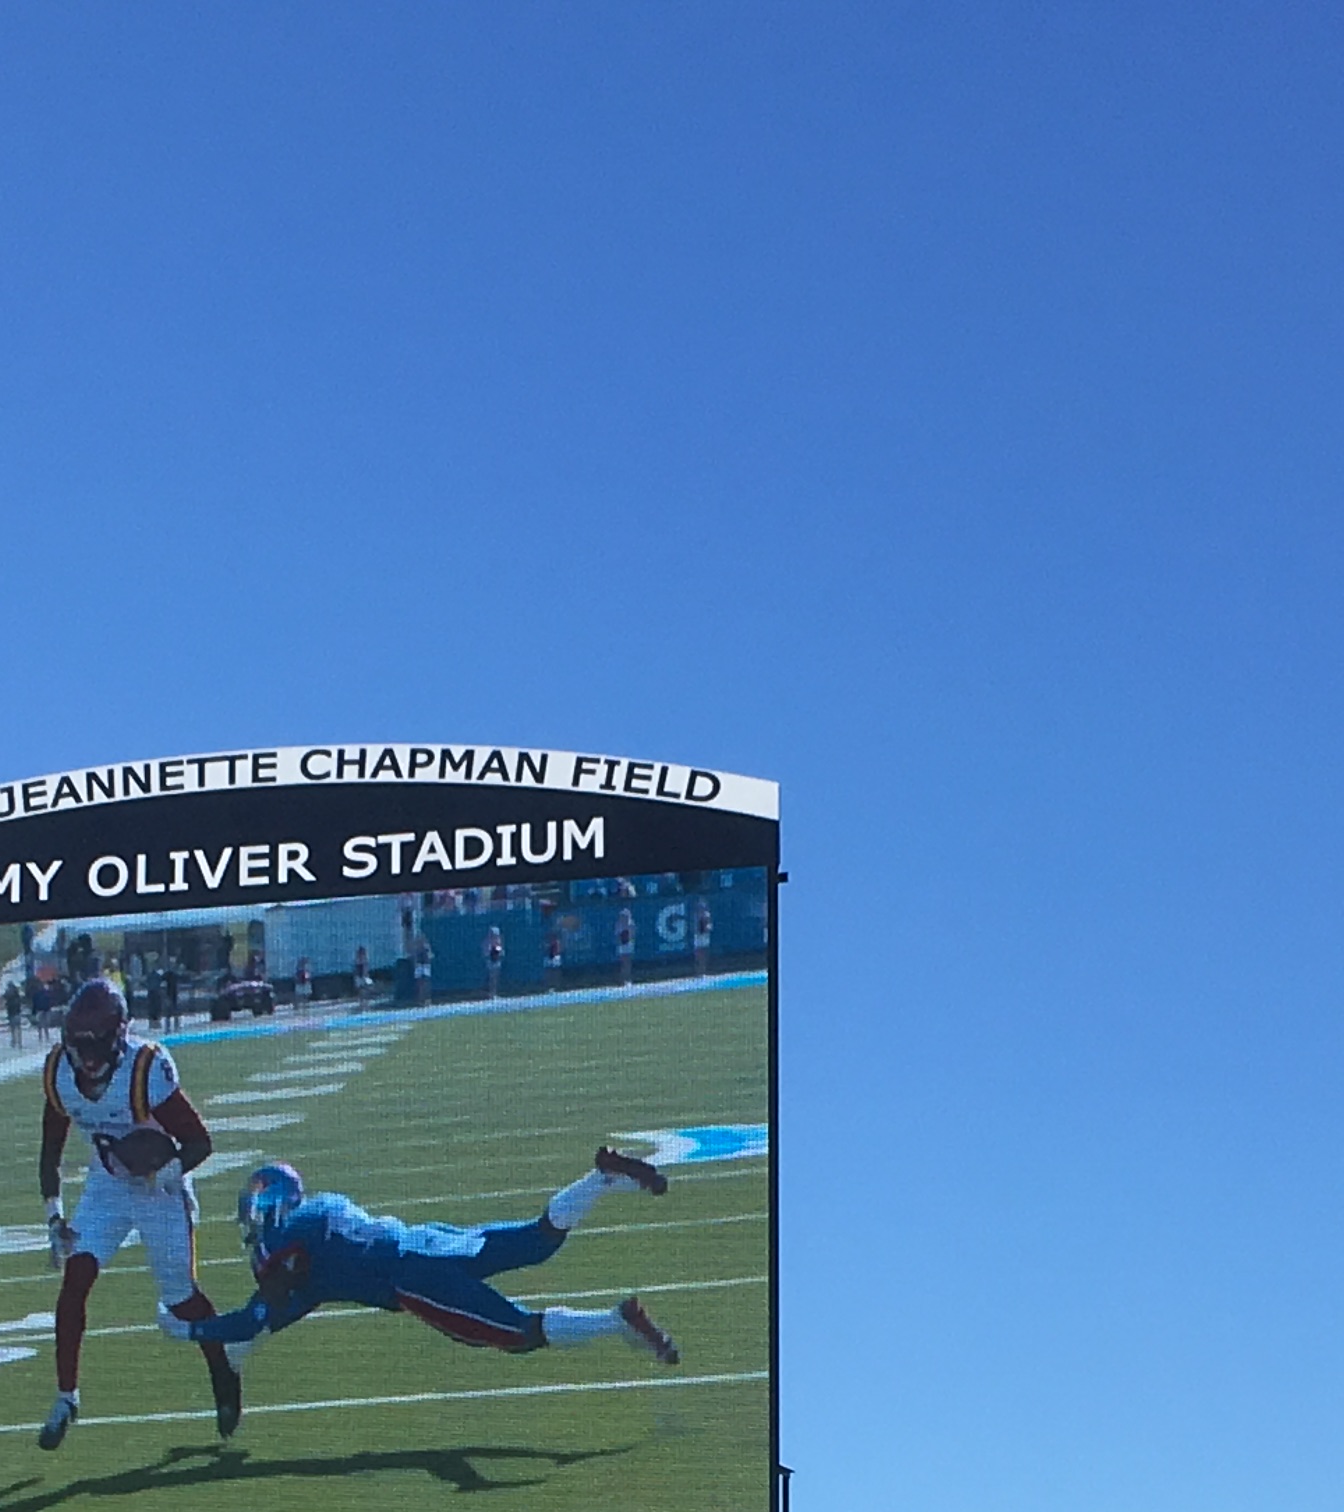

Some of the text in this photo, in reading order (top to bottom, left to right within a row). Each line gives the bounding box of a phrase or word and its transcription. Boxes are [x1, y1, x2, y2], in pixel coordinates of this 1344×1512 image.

[300, 747, 548, 784] CHAPMAN
[571, 756, 722, 802] FIELD
[88, 842, 317, 897] OLIVER
[342, 816, 605, 879] STADIUM
